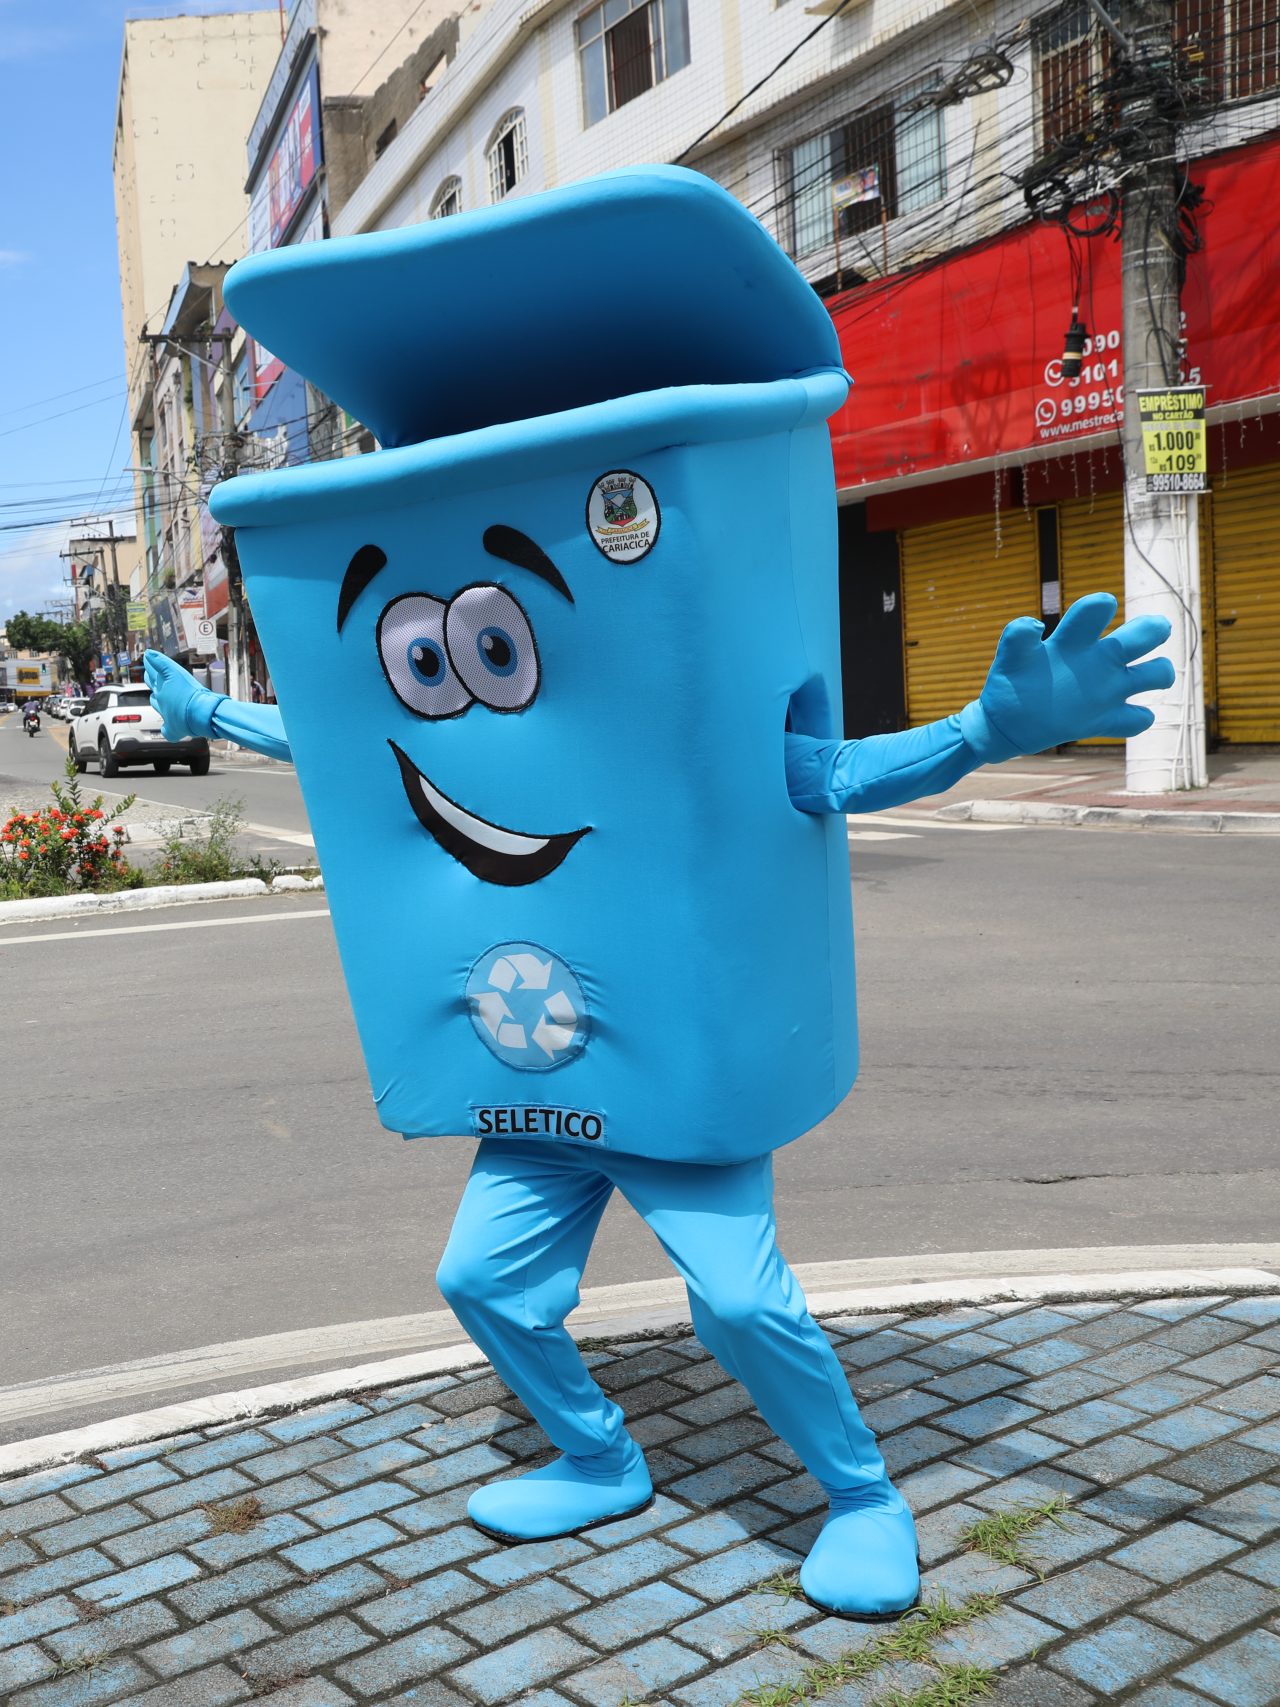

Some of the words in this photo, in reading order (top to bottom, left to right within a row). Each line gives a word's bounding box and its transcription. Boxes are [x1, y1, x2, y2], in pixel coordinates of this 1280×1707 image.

[1138, 391, 1204, 412] EMPRÉSTIMO
[1152, 412, 1163, 420] NO
[1165, 410, 1194, 420] CARTÃO
[1153, 431, 1195, 451] 1.000
[1166, 454, 1196, 471] 109
[601, 533, 638, 545] PREFEITURA
[640, 531, 650, 539] DE
[602, 539, 650, 553] CARIACICA
[203, 623, 209, 633] E
[478, 1108, 602, 1141] SELETICO
